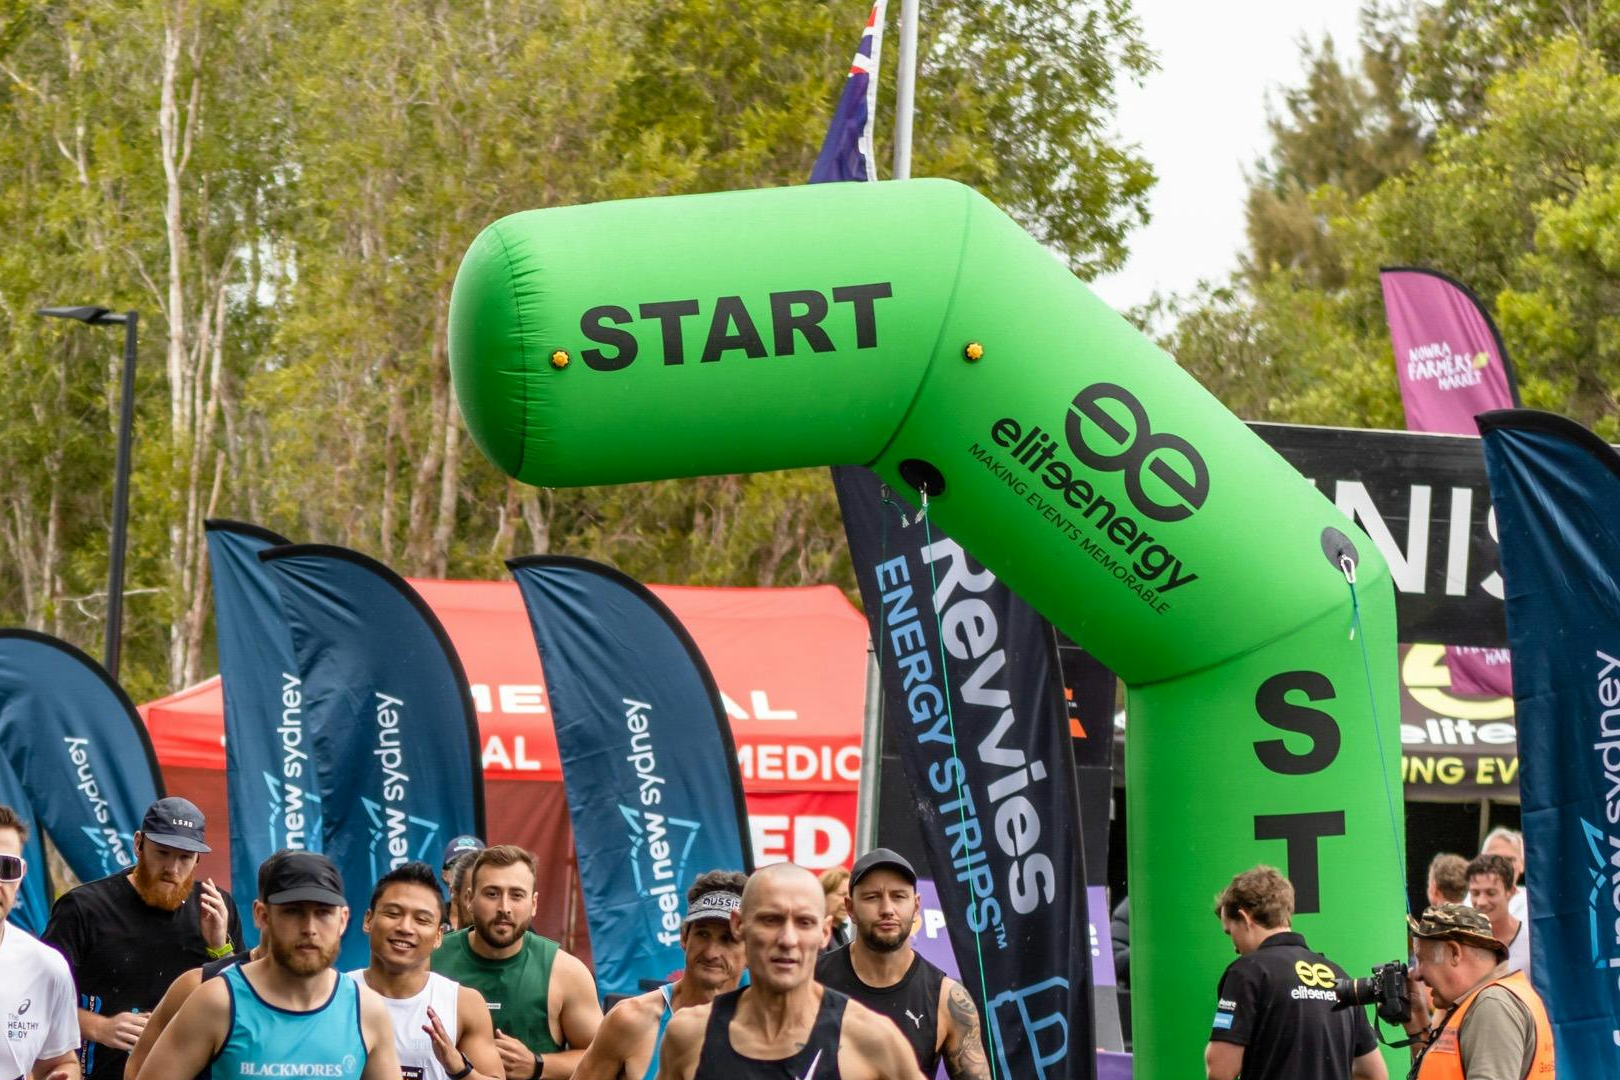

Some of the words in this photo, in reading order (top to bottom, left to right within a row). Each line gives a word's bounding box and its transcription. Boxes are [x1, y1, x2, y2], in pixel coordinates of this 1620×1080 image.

[580, 282, 892, 371] START
[1407, 352, 1473, 382] FARMERS
[968, 443, 1028, 496] MAKING
[1027, 492, 1082, 542] EVENTS
[1079, 537, 1171, 616] MEMORABLE
[991, 418, 1198, 593] eliteenergy
[875, 555, 956, 745] ENERGY
[276, 672, 309, 779] sydney
[373, 691, 410, 801] sydney
[622, 697, 667, 806] sydney
[920, 537, 1056, 914] Revvies
[63, 736, 110, 824] sydney
[284, 783, 305, 851] new
[643, 812, 676, 881] new
[649, 884, 682, 947] feel
[7, 1021, 39, 1030] HEALTHY
[240, 1062, 344, 1078] BLACKMORES
